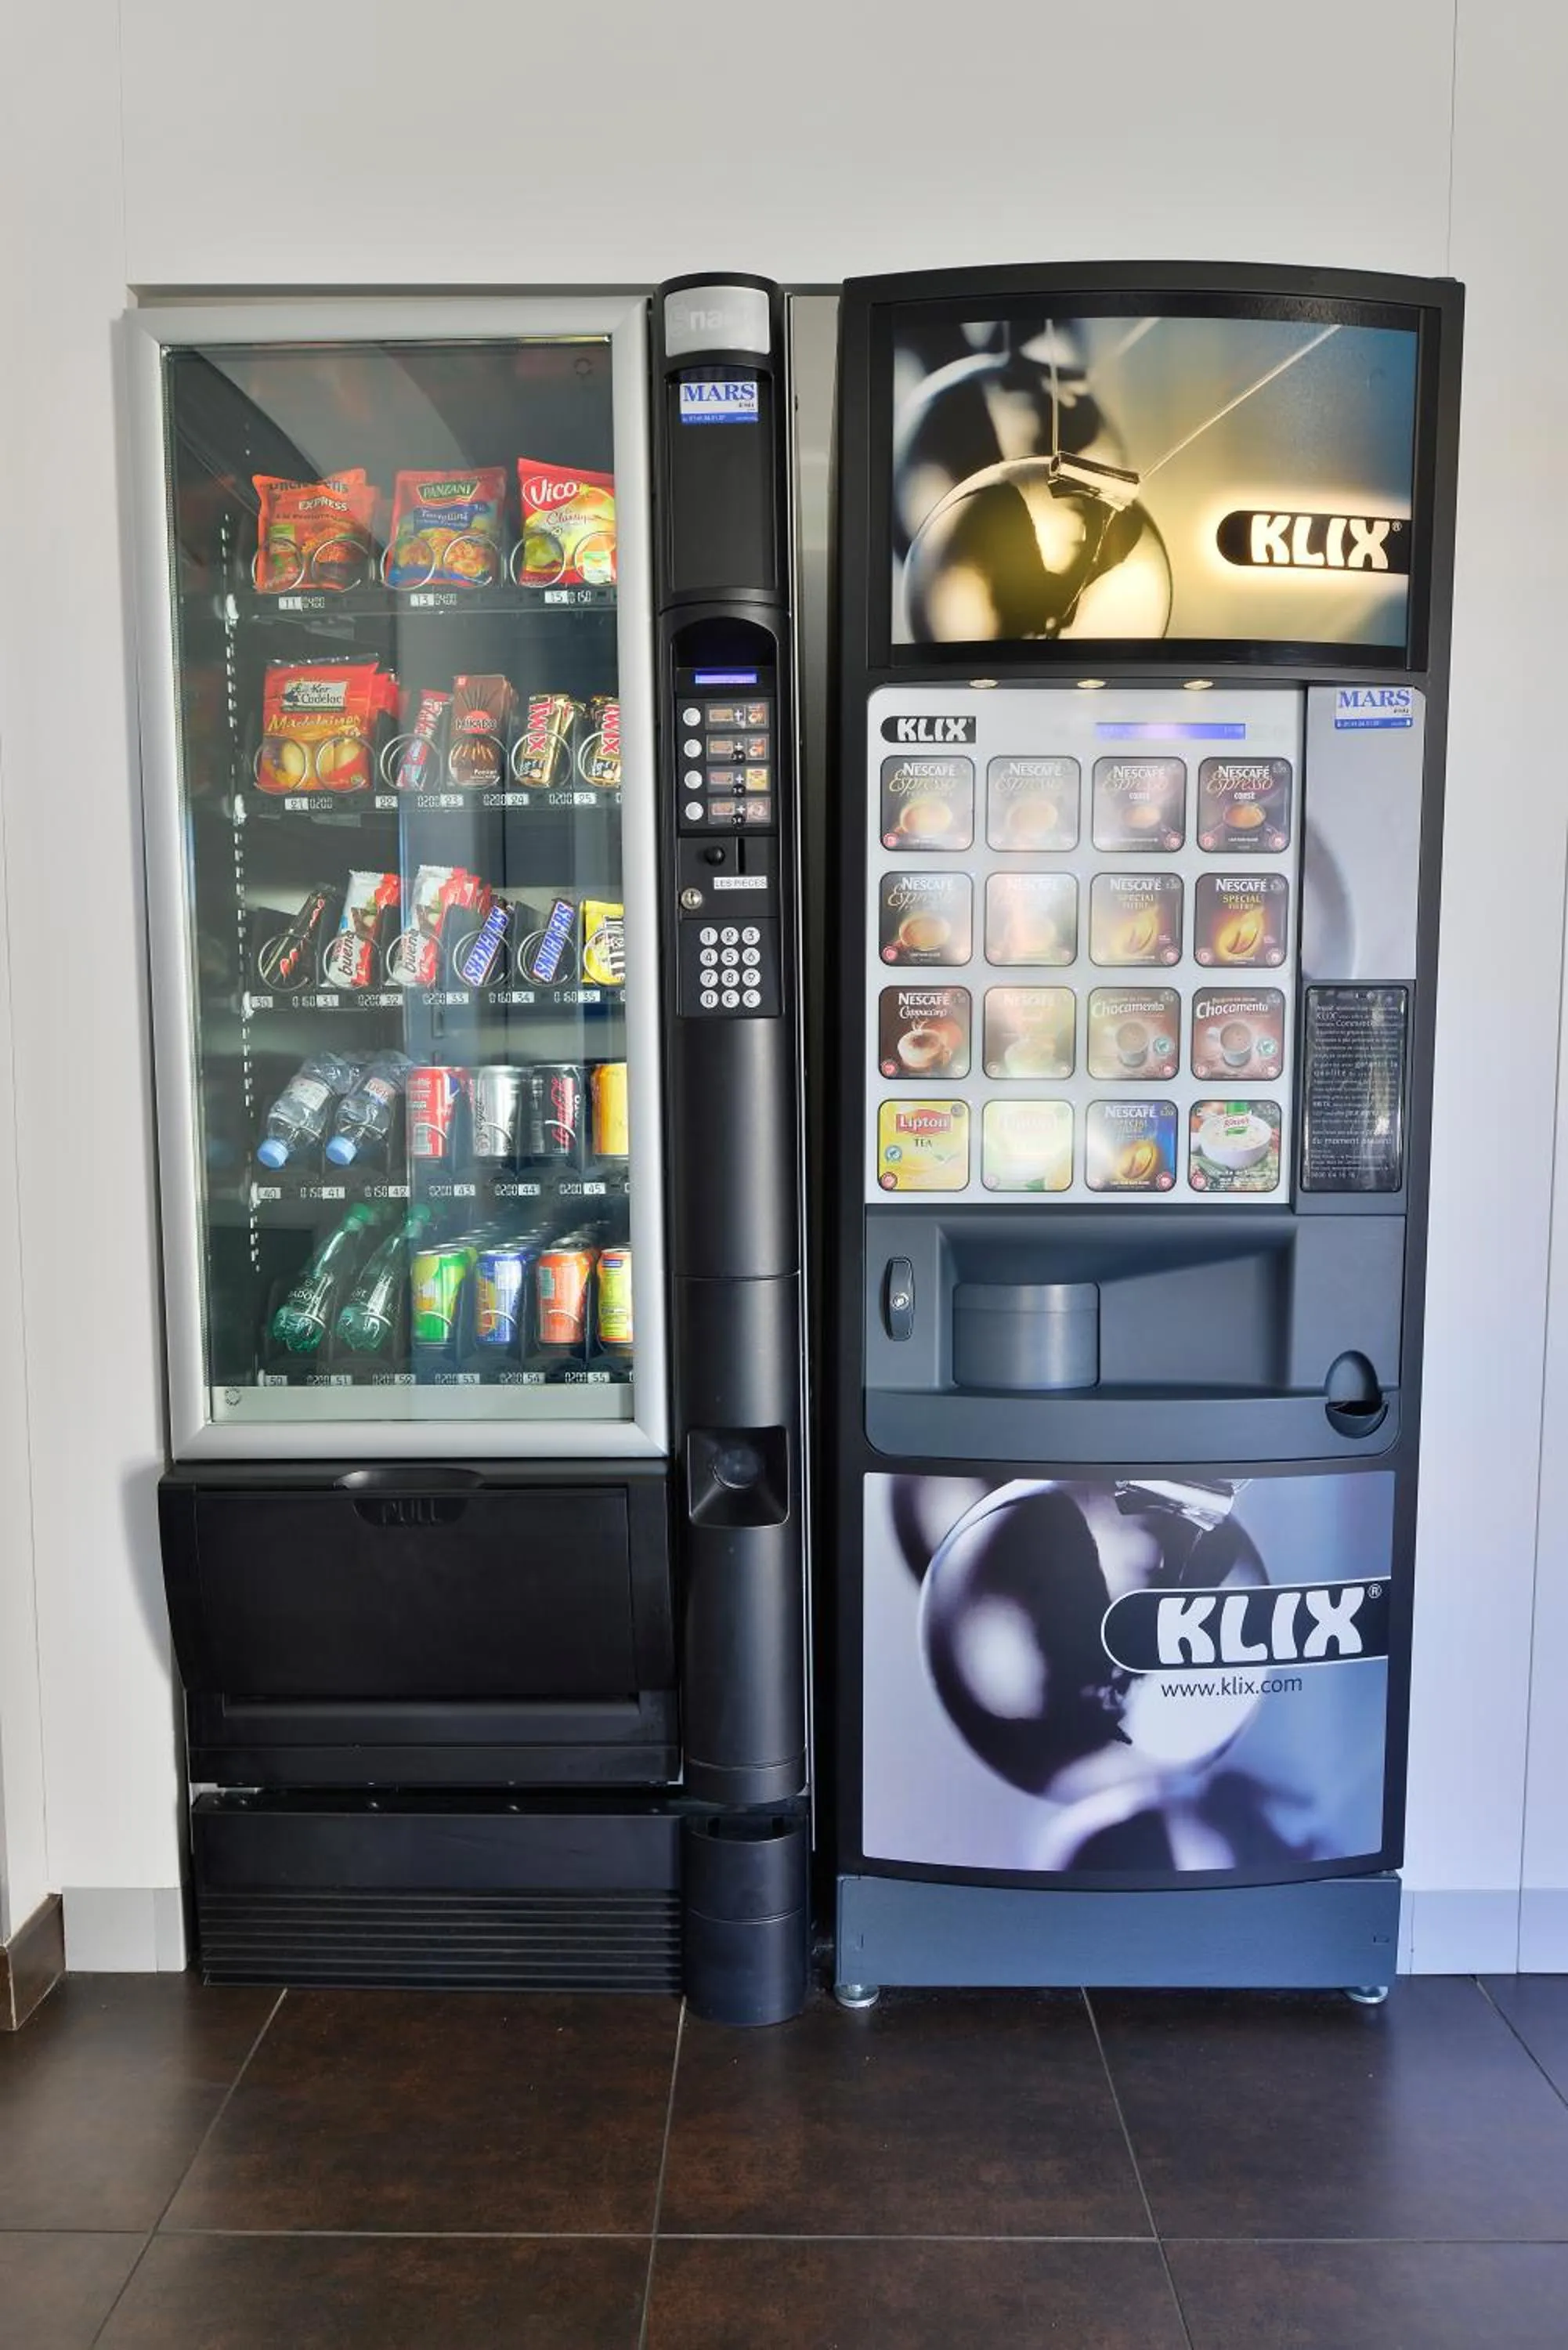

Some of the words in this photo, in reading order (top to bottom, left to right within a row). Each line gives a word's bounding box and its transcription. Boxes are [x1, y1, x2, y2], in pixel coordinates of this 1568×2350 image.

[683, 383, 754, 402] MARS
[423, 484, 471, 500] PANZANI
[530, 479, 578, 505] Vico
[298, 497, 349, 511] EXPRESS
[1339, 689, 1411, 707] MARS
[526, 696, 555, 754] TWIX
[898, 718, 967, 743] KLIX
[1218, 765, 1270, 778] NESCAFÉ
[716, 878, 732, 888] LES
[1216, 878, 1266, 892] NESCAFÉ
[403, 927, 421, 974] bueno
[464, 906, 510, 986] SNICKERS
[533, 902, 576, 982] SNICKERS
[338, 929, 356, 977] bueno
[900, 1115, 947, 1131] Lipton
[913, 1138, 933, 1148] TEA
[1157, 1586, 1365, 1665] KLIX
[1161, 1676, 1302, 1697] www.klix.com
